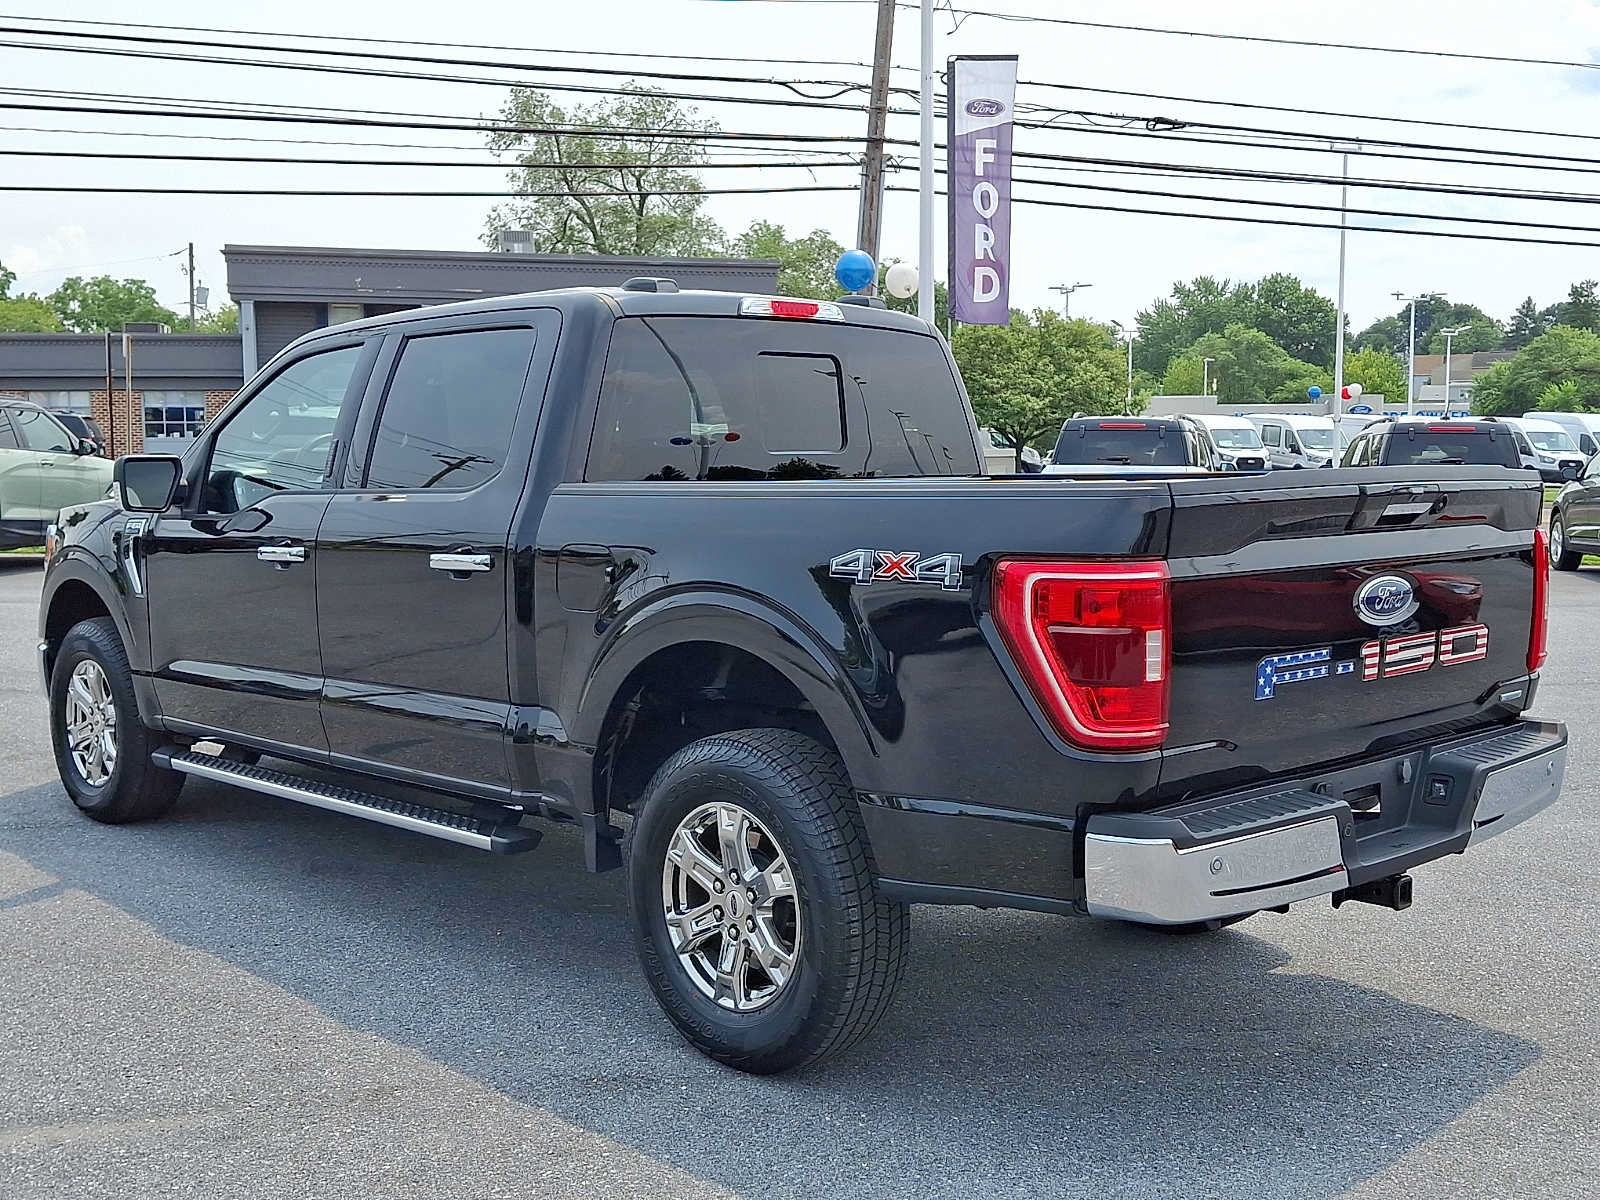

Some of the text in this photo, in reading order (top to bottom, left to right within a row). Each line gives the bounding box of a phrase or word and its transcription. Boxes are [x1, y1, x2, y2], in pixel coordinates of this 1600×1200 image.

[971, 101, 998, 114] Ford
[973, 138, 1000, 303] FORD
[1374, 586, 1405, 611] Ford
[1254, 623, 1489, 700] F-150
